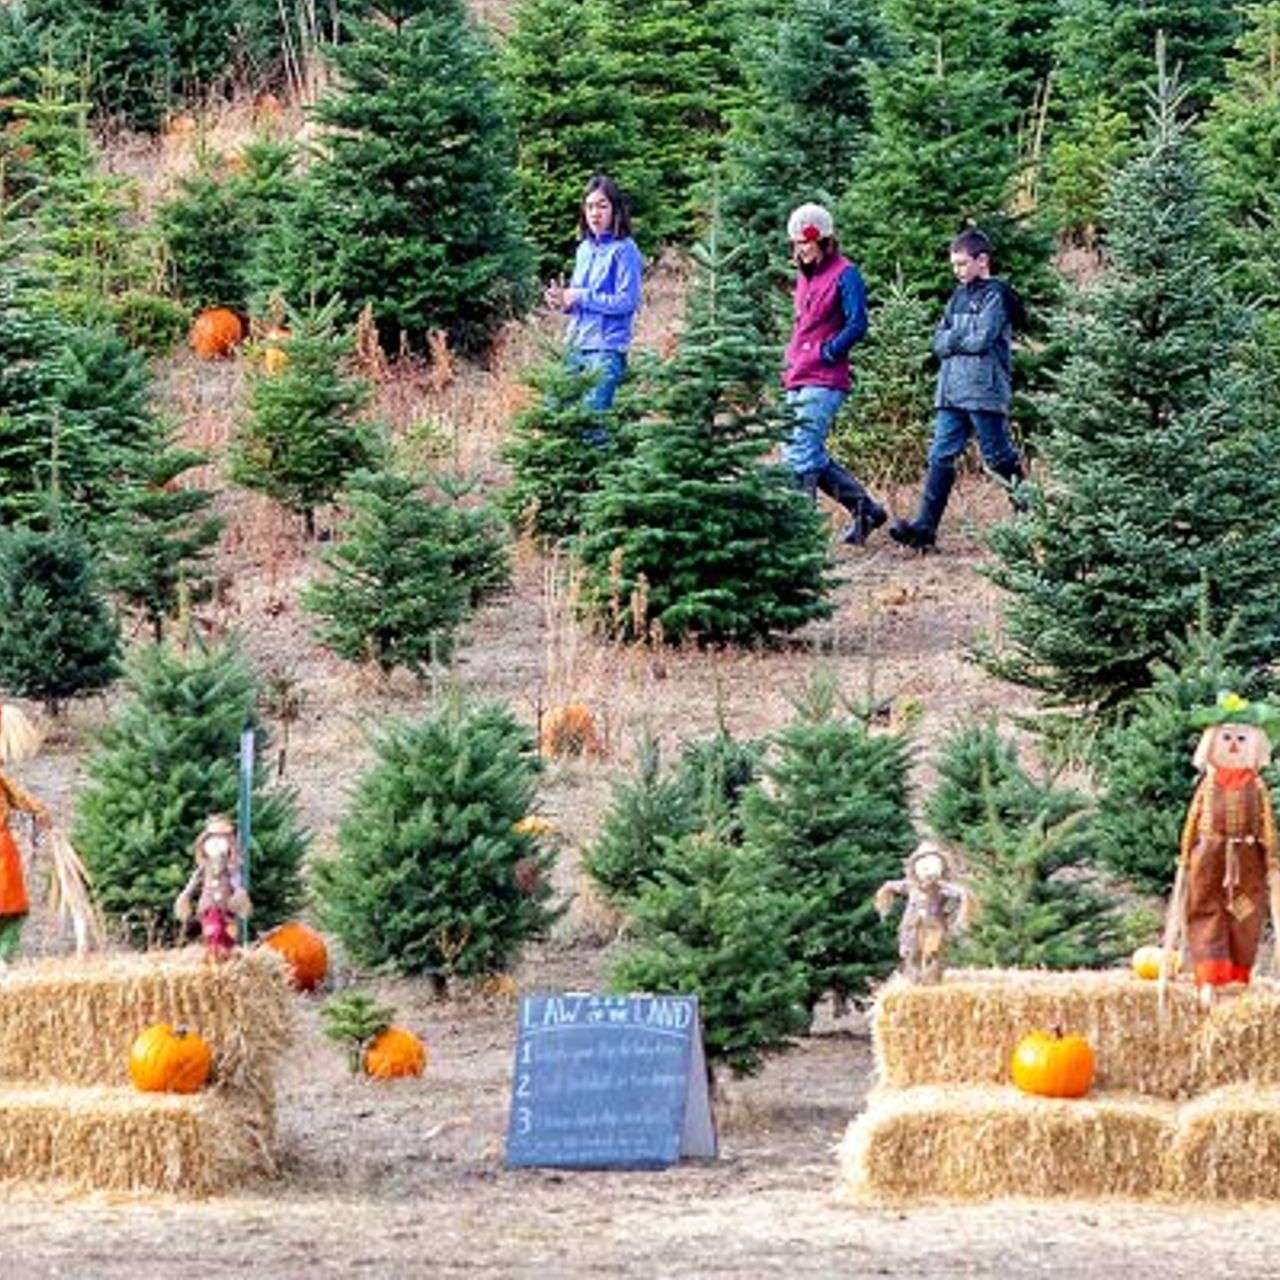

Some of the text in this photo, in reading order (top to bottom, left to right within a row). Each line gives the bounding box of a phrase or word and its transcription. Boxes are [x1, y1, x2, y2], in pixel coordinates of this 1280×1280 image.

[523, 997, 581, 1027] LAW
[633, 997, 692, 1028] LAND
[519, 1041, 532, 1064] 1
[516, 1074, 532, 1097] 2
[516, 1106, 532, 1134] 3
